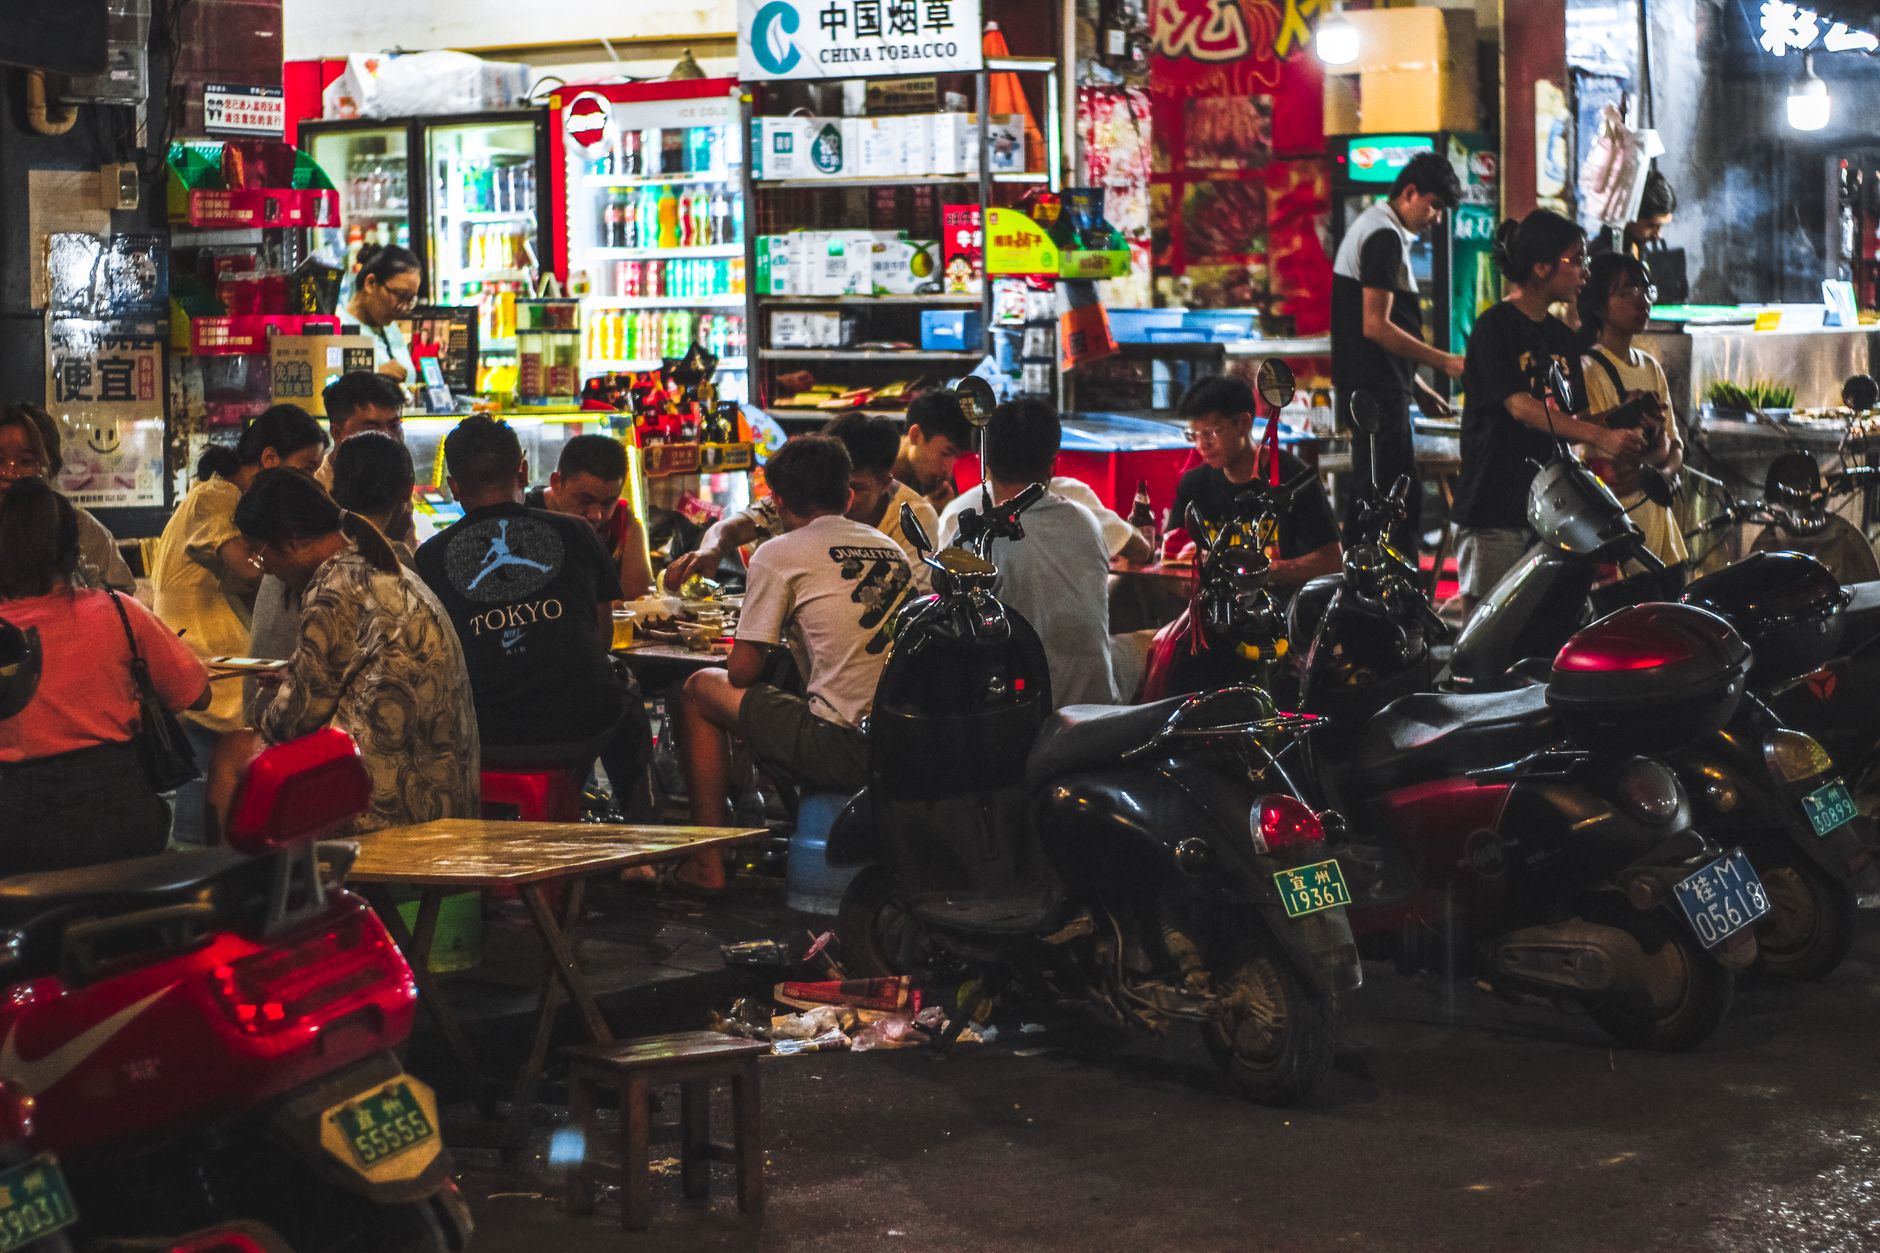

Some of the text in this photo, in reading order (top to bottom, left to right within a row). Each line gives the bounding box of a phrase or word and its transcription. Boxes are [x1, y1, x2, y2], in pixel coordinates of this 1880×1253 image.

[820, 0, 954, 41] 中国烟草
[820, 42, 958, 63] CHINA TOBACCO
[52, 356, 137, 403] 便宜
[470, 599, 562, 635] TOKYO
[1813, 799, 1852, 832] 30899
[1289, 870, 1331, 891] 宜州
[1290, 882, 1344, 912] 19367
[1696, 881, 1765, 942] 05618
[356, 1110, 428, 1161] 55555
